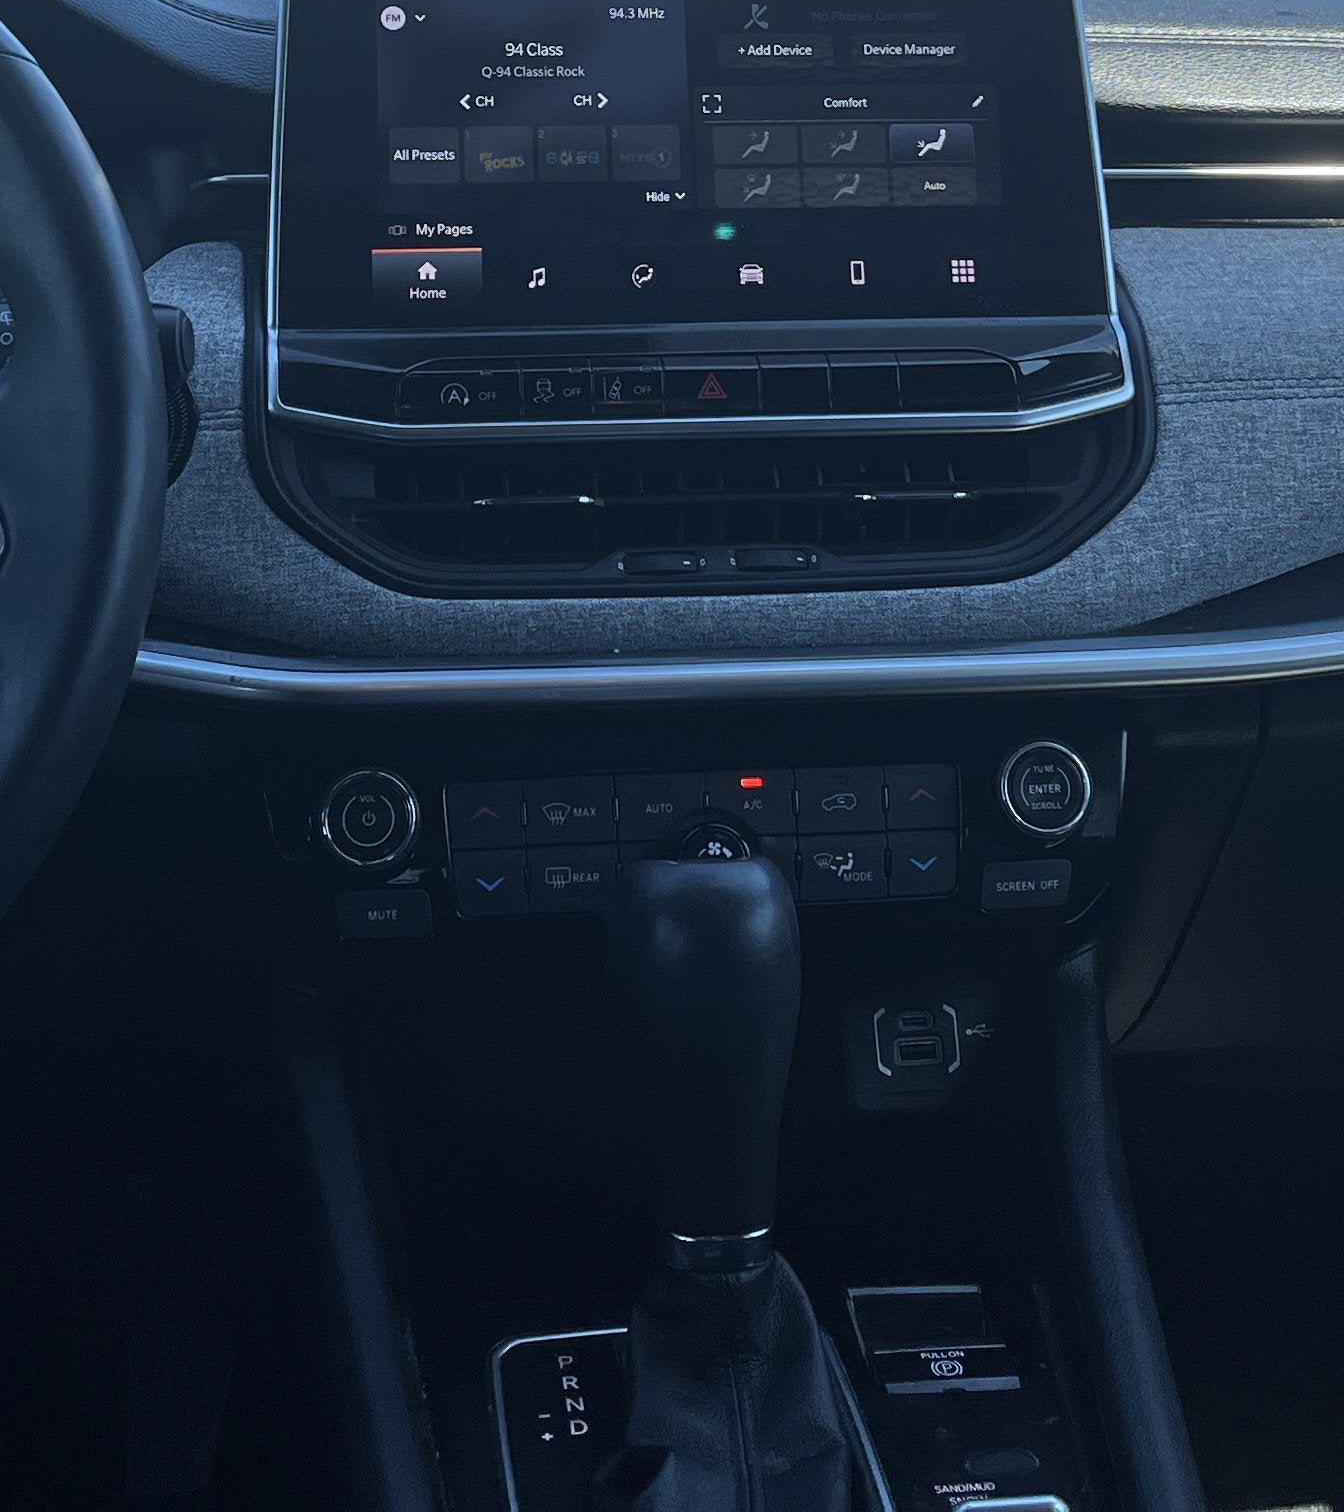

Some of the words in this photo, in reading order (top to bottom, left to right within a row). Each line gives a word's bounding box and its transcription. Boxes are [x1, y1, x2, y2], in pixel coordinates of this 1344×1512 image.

[385, 13, 401, 23] FM
[609, 7, 635, 20] 94.3
[637, 7, 665, 20] MHz
[505, 43, 524, 56] 94
[526, 43, 564, 56] Class
[747, 44, 771, 57] Add
[773, 44, 813, 57] Device
[863, 44, 902, 56] Device
[904, 44, 956, 58] Manager
[481, 66, 512, 79] Q-94
[513, 66, 554, 78] Classic
[557, 65, 586, 77] Rock
[475, 96, 495, 107] CH
[573, 95, 592, 106] CH
[823, 97, 868, 109] Comfort
[538, 130, 545, 139] 2
[611, 129, 618, 139] 3
[393, 149, 409, 161] All
[411, 149, 456, 162] Presets
[923, 181, 946, 191] Auto
[646, 191, 670, 202] Hide
[416, 224, 435, 237] My
[437, 224, 473, 237] Pages
[409, 287, 447, 300] Home
[562, 388, 582, 398] OFF
[633, 385, 653, 395] OFF
[478, 391, 497, 401] OFF
[1033, 764, 1055, 775] TUNE
[1028, 783, 1062, 795] ENTER
[359, 794, 376, 804] VOL
[743, 799, 763, 810] A/C
[645, 803, 674, 814] AUTO
[1031, 800, 1063, 811] SCROLL
[573, 807, 597, 818] MAX
[572, 872, 600, 883] REAR
[843, 871, 873, 882] MODE
[995, 880, 1035, 892] SCREEN
[1040, 879, 1060, 890] OFF
[368, 909, 398, 921] MUTE
[920, 1351, 948, 1360] PULL
[948, 1350, 965, 1359] ON
[558, 1355, 574, 1369] P
[561, 1375, 579, 1390] R
[565, 1397, 585, 1412] N
[569, 1419, 589, 1435] D
[934, 1482, 996, 1495] SAND/MUD
